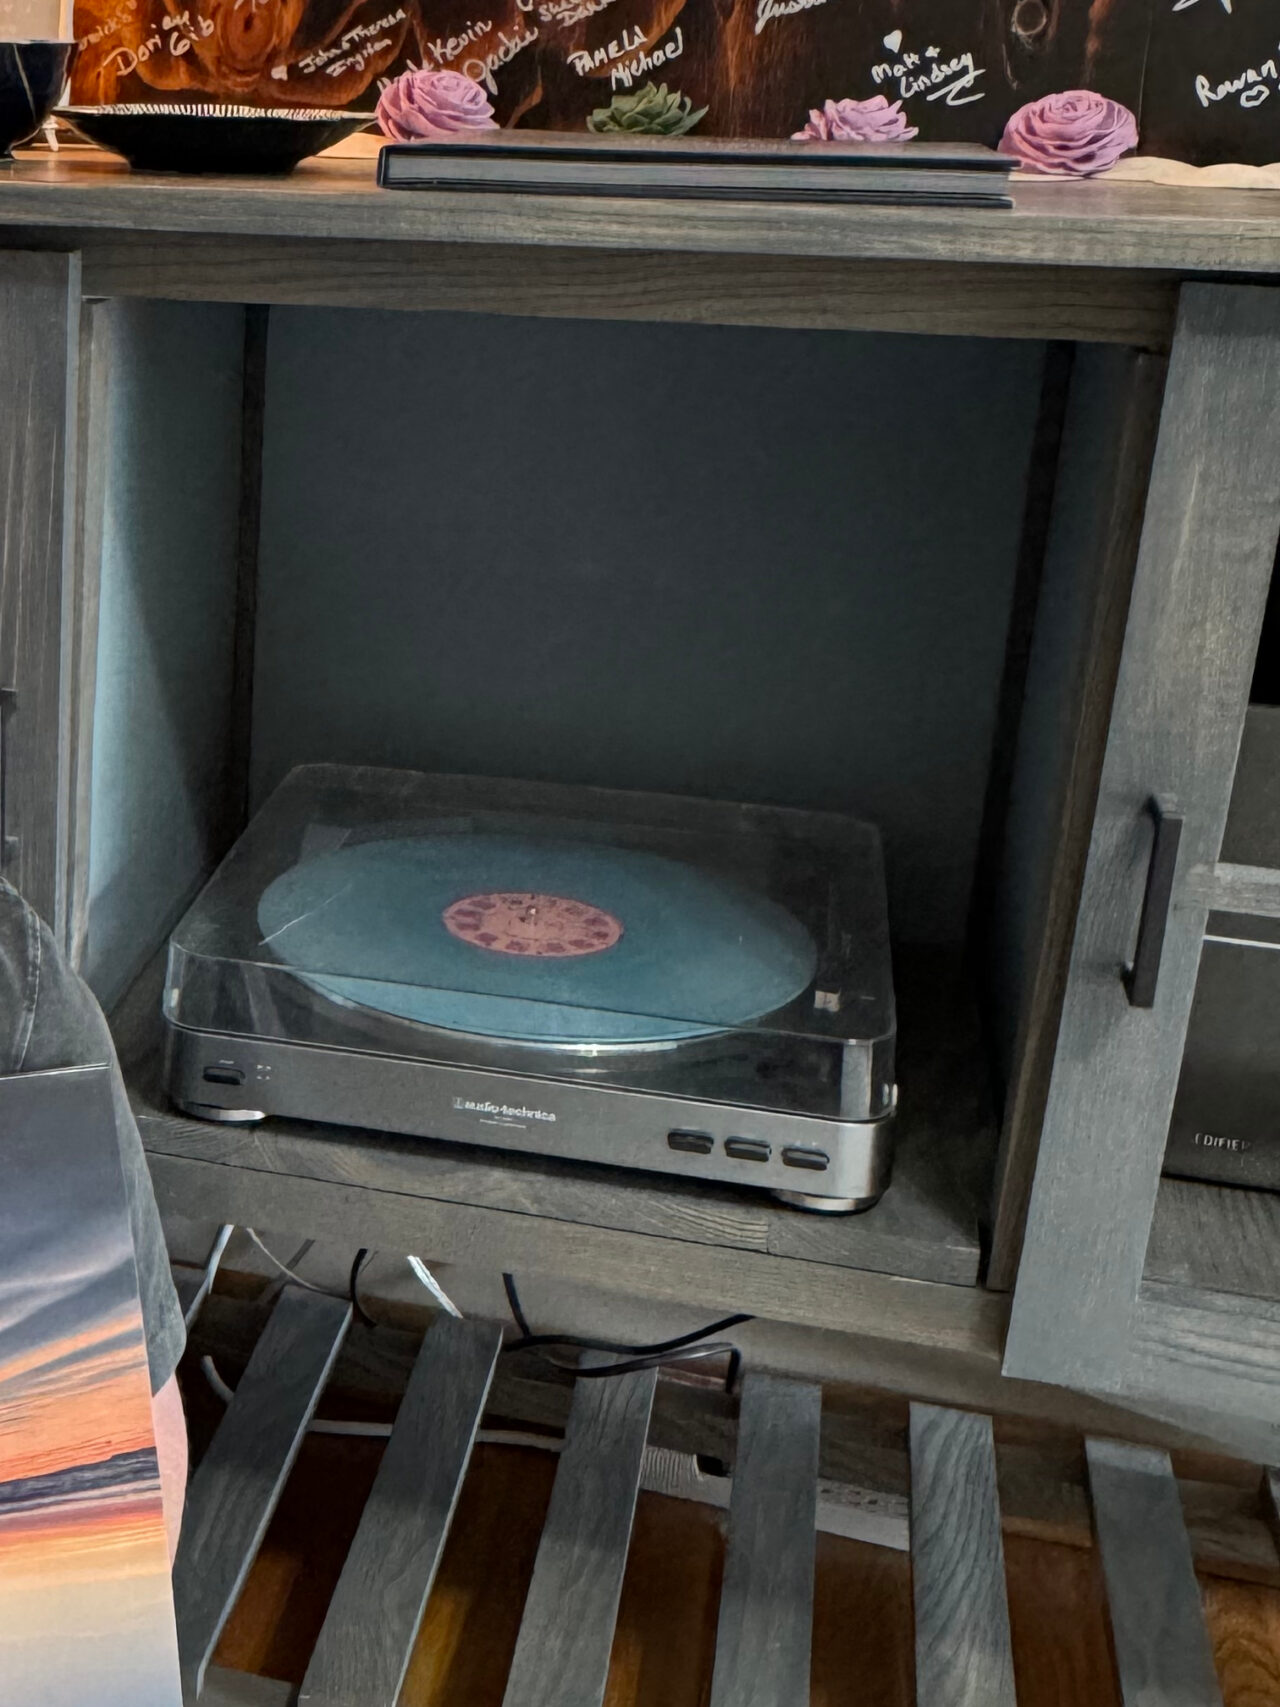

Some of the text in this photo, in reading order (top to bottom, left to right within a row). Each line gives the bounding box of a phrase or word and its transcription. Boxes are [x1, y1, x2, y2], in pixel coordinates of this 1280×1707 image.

[298, 50, 343, 74] John
[427, 20, 492, 64] Kevin
[567, 25, 648, 76] PAMELA
[611, 26, 684, 91] Michael
[871, 53, 921, 84] Matt
[900, 52, 986, 106] Lindsey
